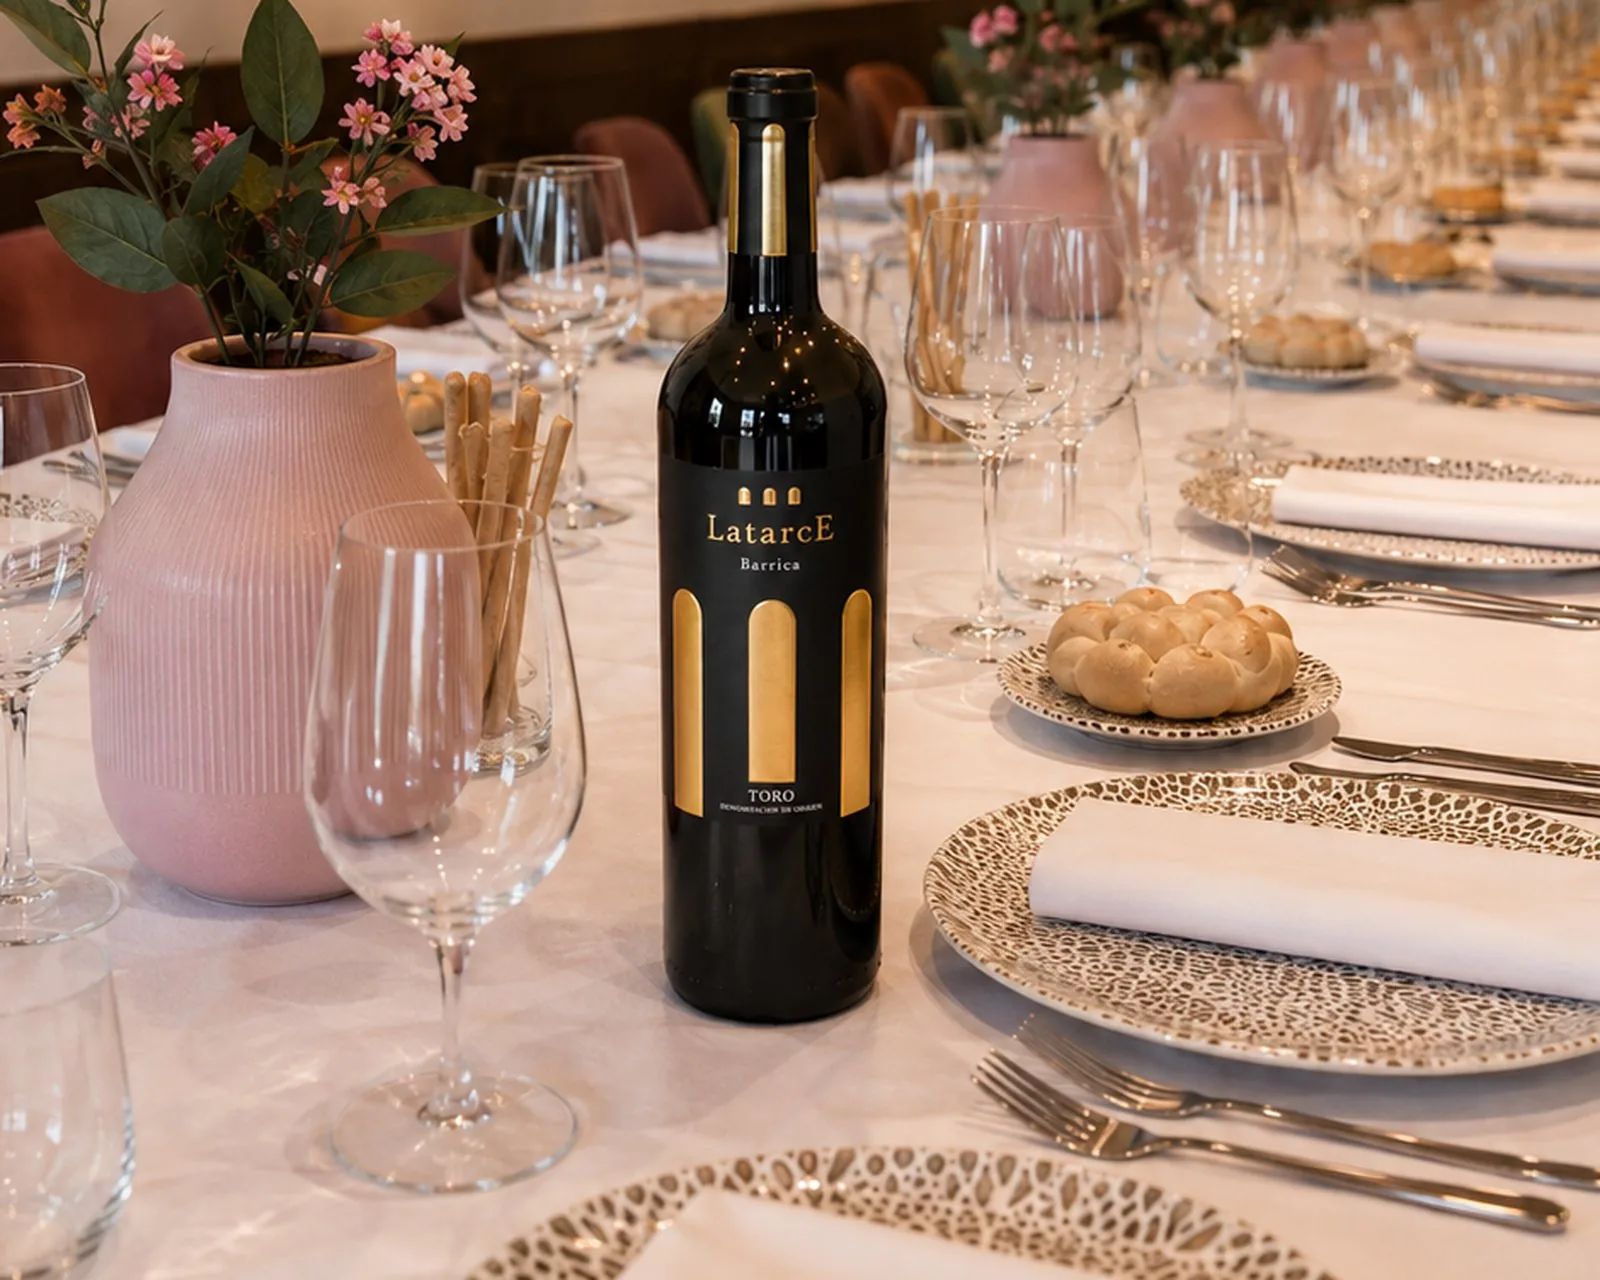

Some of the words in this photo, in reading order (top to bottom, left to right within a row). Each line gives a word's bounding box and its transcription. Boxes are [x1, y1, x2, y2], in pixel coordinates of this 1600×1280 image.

[707, 513, 834, 544] LatarcE
[740, 557, 801, 571] Barrica
[748, 789, 795, 803] TORO
